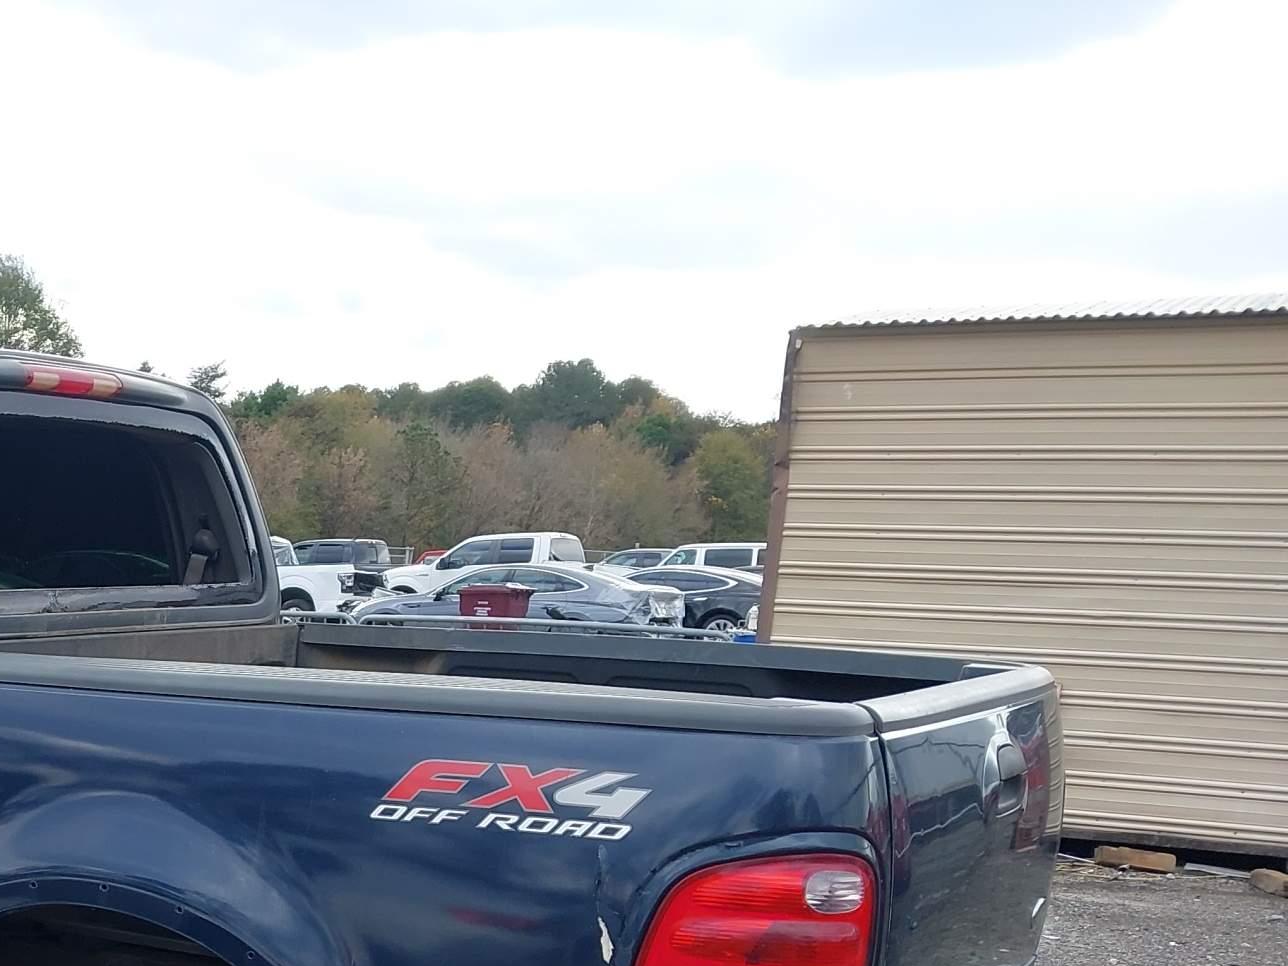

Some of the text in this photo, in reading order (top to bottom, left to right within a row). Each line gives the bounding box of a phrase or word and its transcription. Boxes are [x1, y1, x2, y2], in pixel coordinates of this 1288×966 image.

[380, 758, 654, 820] FX4
[369, 804, 633, 841] OFF ROAD
